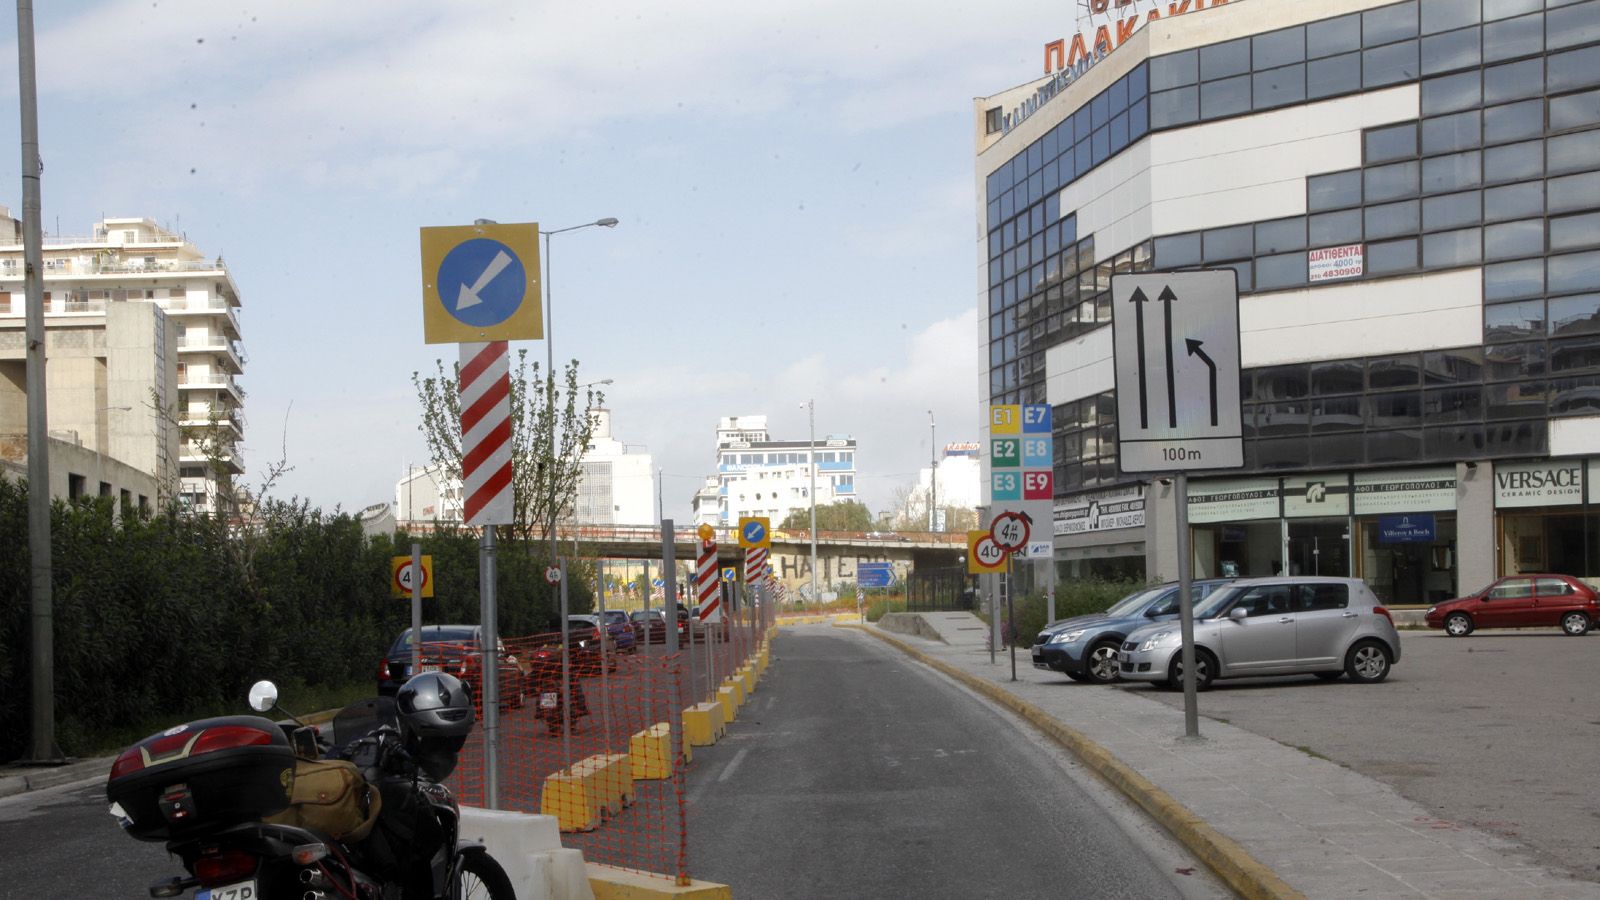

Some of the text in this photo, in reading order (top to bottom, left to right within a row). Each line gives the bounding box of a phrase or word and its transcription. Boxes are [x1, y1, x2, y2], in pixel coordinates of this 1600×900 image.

[1044, 0, 1229, 74] ΠΛΑΚ
[1310, 245, 1365, 262] ΔΙΑΤΙΘΕΝΤΑΙ
[1322, 266, 1361, 278] 4830900
[993, 408, 1012, 425] E1
[1024, 407, 1046, 424] E7
[993, 441, 1015, 458] E2
[1025, 440, 1047, 457] E8
[993, 474, 1016, 491] E3
[1025, 474, 1048, 491] E9
[1497, 468, 1580, 489] VERSACE
[1502, 488, 1580, 498] CERAMIC DESIGN
[981, 545, 1000, 558] 40
